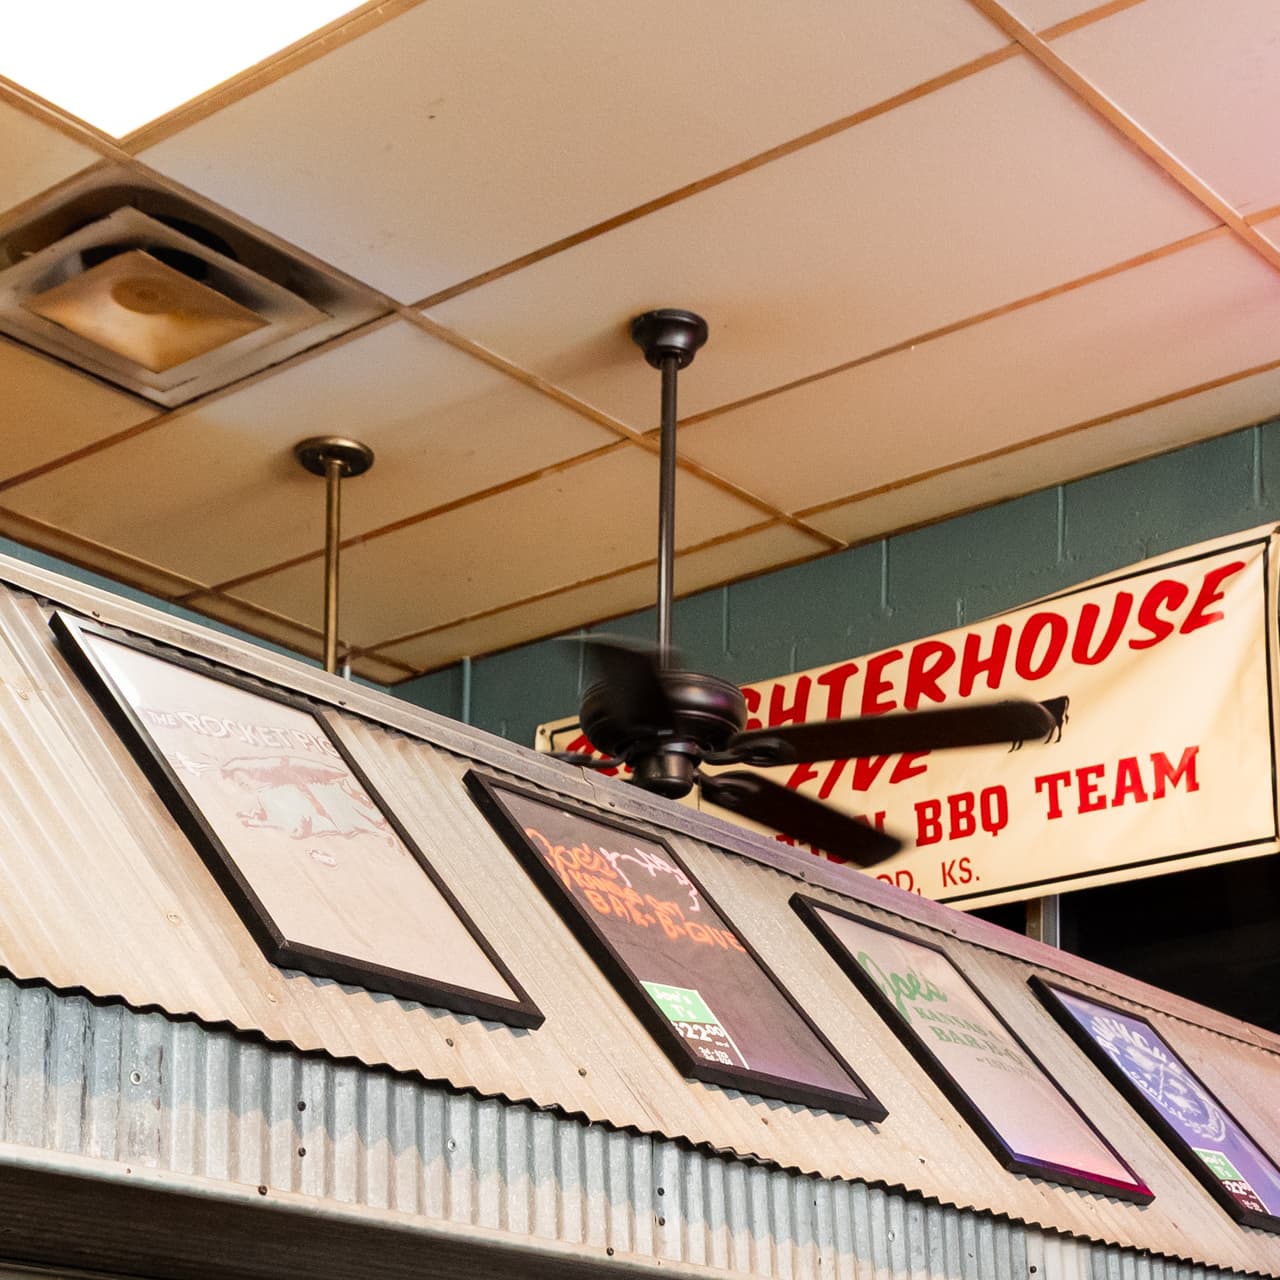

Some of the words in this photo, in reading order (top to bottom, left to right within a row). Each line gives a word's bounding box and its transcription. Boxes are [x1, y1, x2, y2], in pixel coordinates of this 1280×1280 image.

[178, 711, 295, 749] ROCKET
[915, 784, 1010, 847] BBQ
[1034, 745, 1200, 820] TEAM
[940, 856, 981, 888] KS.
